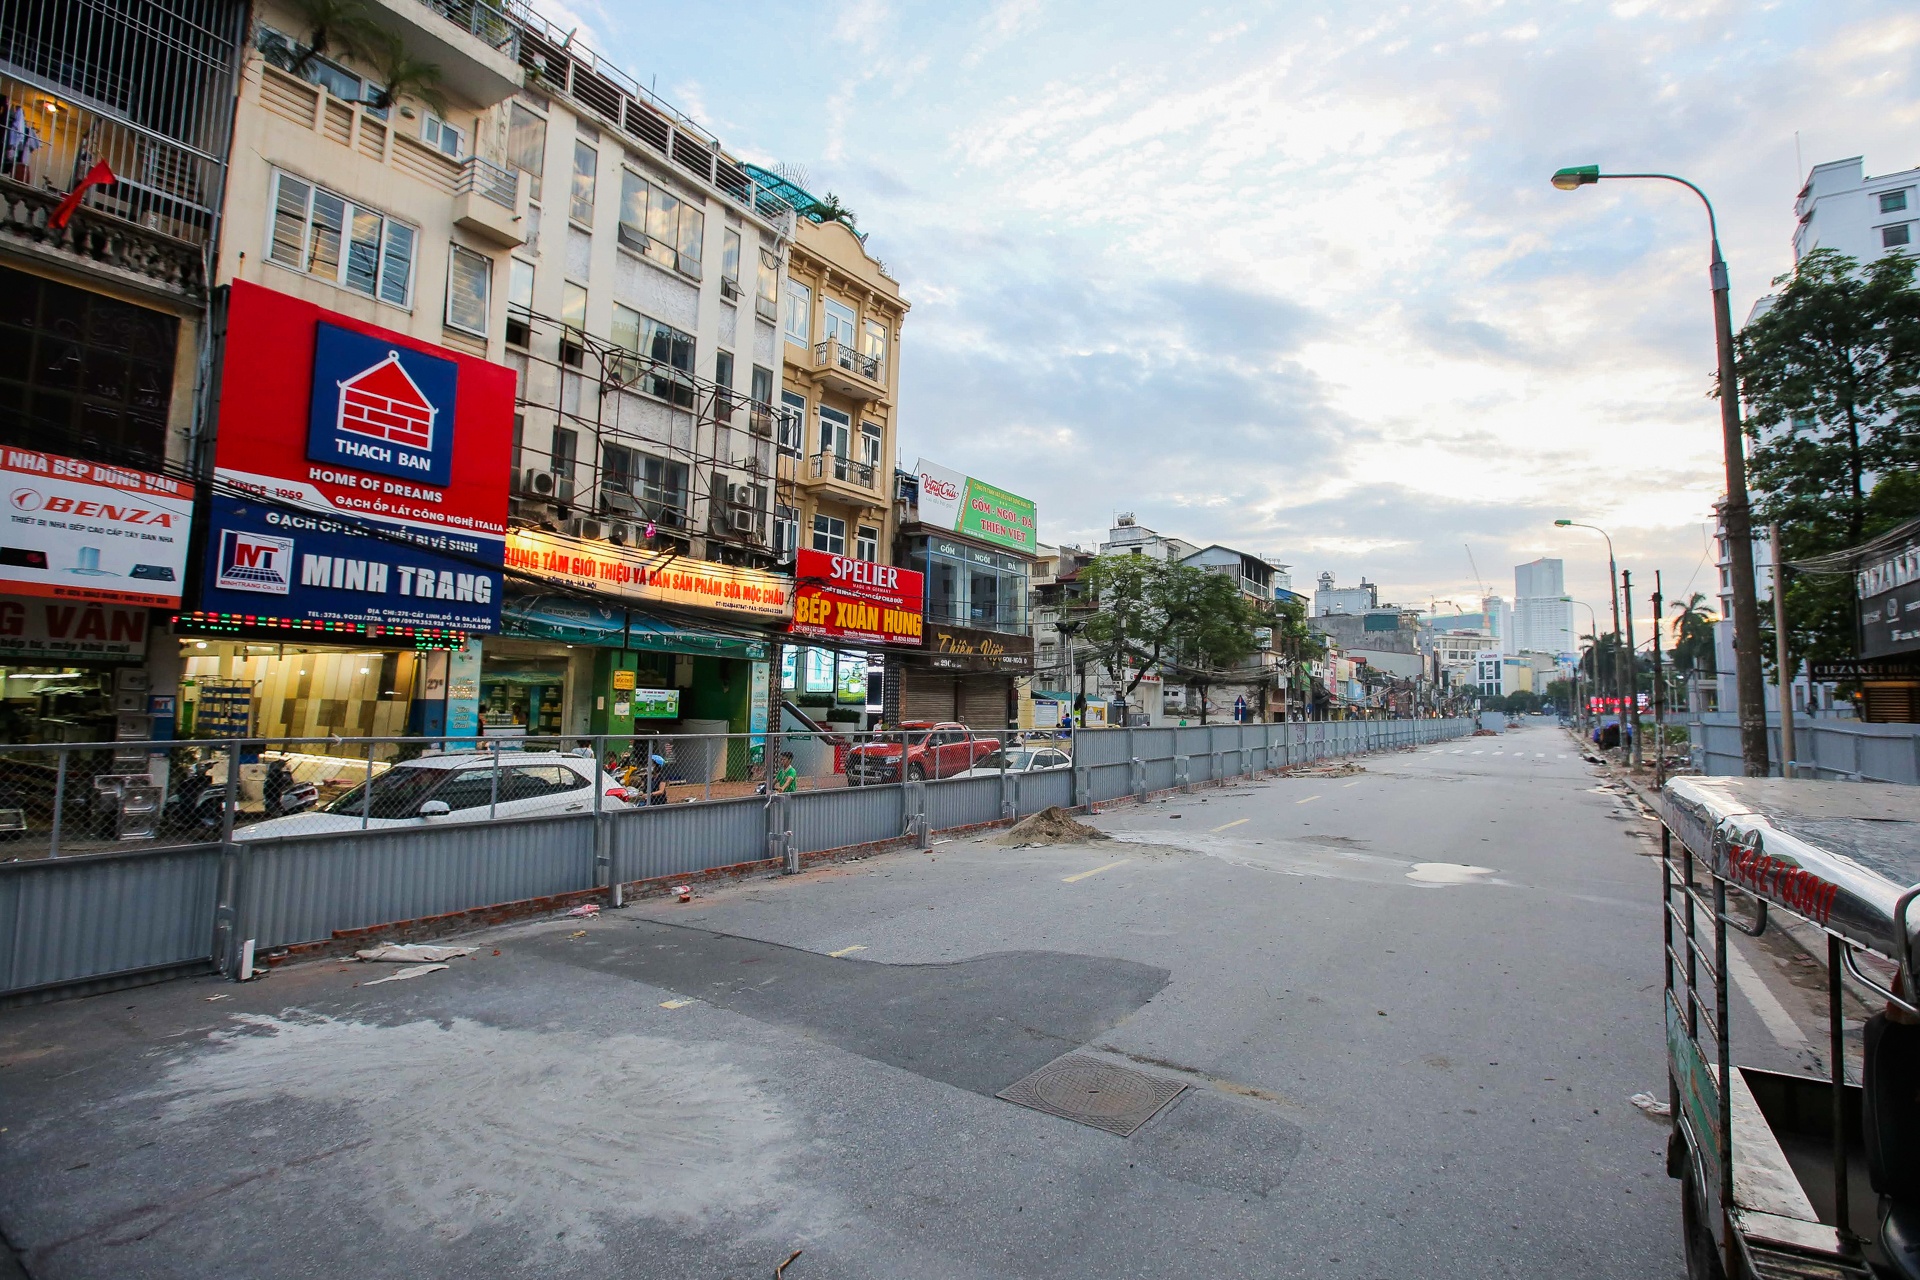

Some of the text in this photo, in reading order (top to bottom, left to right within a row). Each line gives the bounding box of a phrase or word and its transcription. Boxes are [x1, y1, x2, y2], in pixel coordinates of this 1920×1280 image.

[8, 453, 48, 472] NHÀ
[52, 458, 90, 478] BẾP
[335, 438, 430, 471] THACH BAN
[227, 480, 303, 500] SINCE 1959
[309, 468, 442, 503] HOME OF DREAMS
[43, 496, 172, 528] BENZA
[335, 496, 504, 532] GẠCH ỐP LÁT CÔNG NGHỆ ITALIA
[972, 497, 990, 516] GỐM
[87, 526, 104, 534] CAO
[266, 512, 316, 530] GẠCH
[448, 540, 478, 553] SINH
[1008, 527, 1026, 543] VIỆT
[940, 544, 955, 555] GỐM
[975, 554, 990, 564] NGÓI
[300, 554, 492, 604] MINH TRANG
[543, 550, 569, 574] TÂM
[572, 556, 596, 578] GIỚI
[600, 562, 630, 584] THIỆU
[634, 566, 646, 585] VÀ
[672, 572, 692, 592] SẢN
[695, 576, 722, 596] PHẨM
[724, 580, 740, 600] SỮA
[743, 584, 761, 604] MỘC
[763, 588, 784, 606] CHÂU
[830, 556, 898, 589] SPELIER
[1008, 561, 1016, 571] ĐÁ
[220, 580, 261, 588] MINHTRANG
[46, 602, 144, 642] VÂN
[796, 592, 831, 625] BẾP
[835, 601, 879, 631] XUÂN
[883, 606, 922, 636] HÙNG
